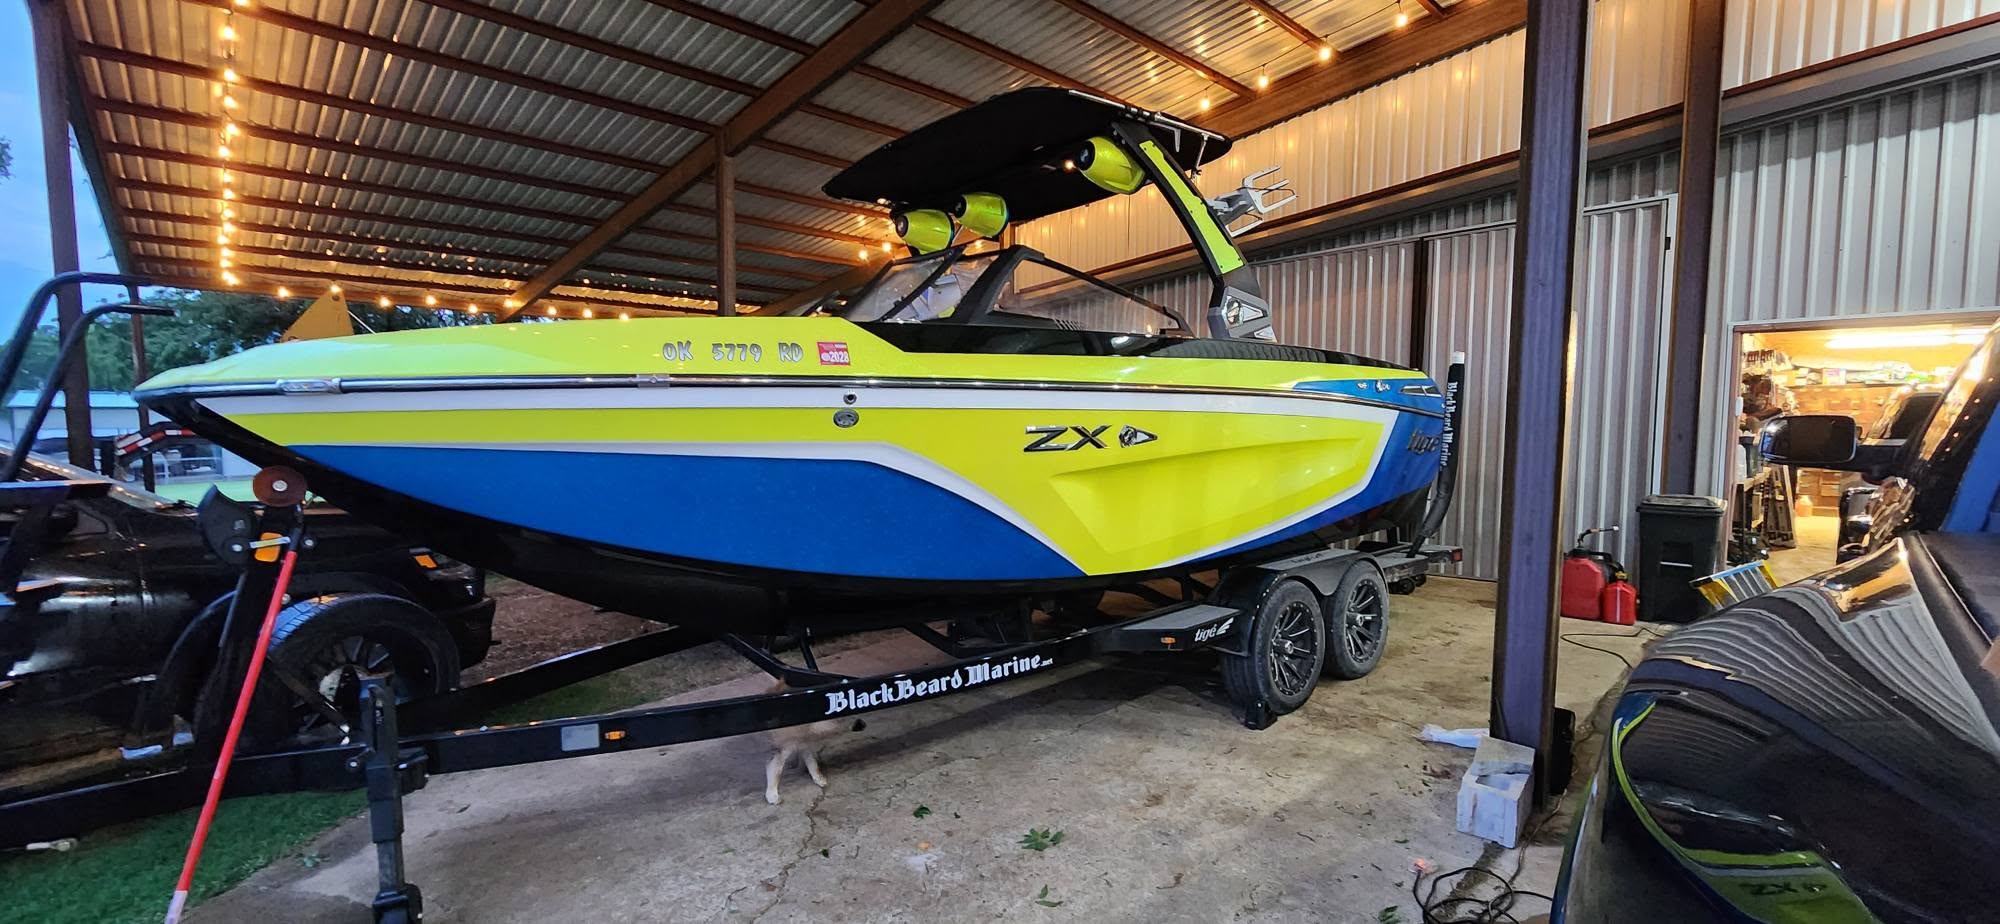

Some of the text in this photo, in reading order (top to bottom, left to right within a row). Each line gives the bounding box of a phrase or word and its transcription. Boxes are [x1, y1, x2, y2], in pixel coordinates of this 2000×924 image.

[662, 340, 804, 362] OK 5779 RD
[1023, 424, 1112, 453] ZX
